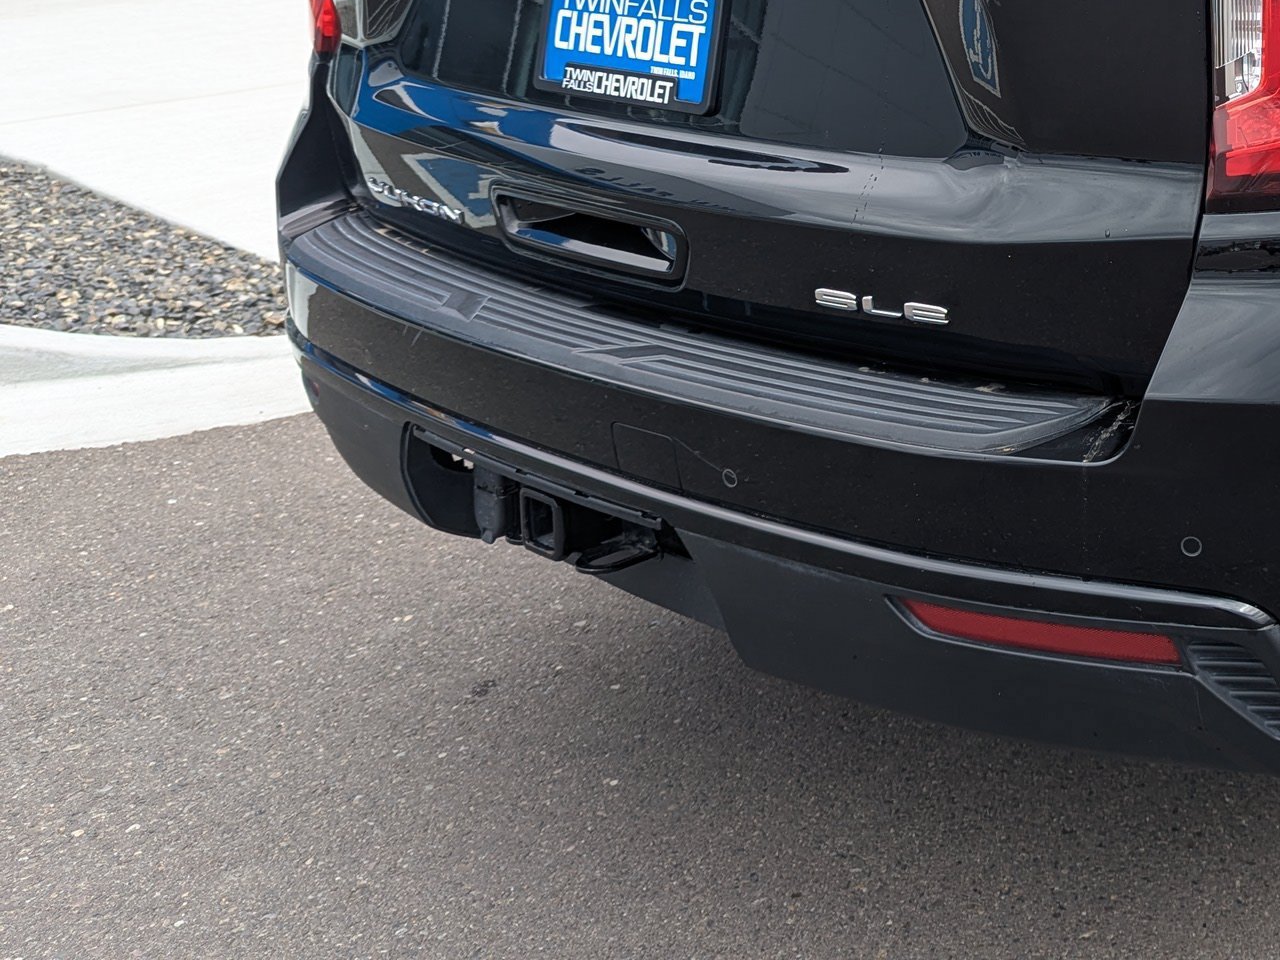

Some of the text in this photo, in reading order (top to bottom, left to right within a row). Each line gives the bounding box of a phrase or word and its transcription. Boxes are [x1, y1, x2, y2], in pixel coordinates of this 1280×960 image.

[554, 8, 706, 67] CHEVROLET
[561, 77, 595, 92] FALLS
[564, 66, 596, 83] TWIN
[593, 73, 674, 105] CHEVROLET
[367, 177, 465, 225] YUKON
[814, 287, 949, 326] SLE
